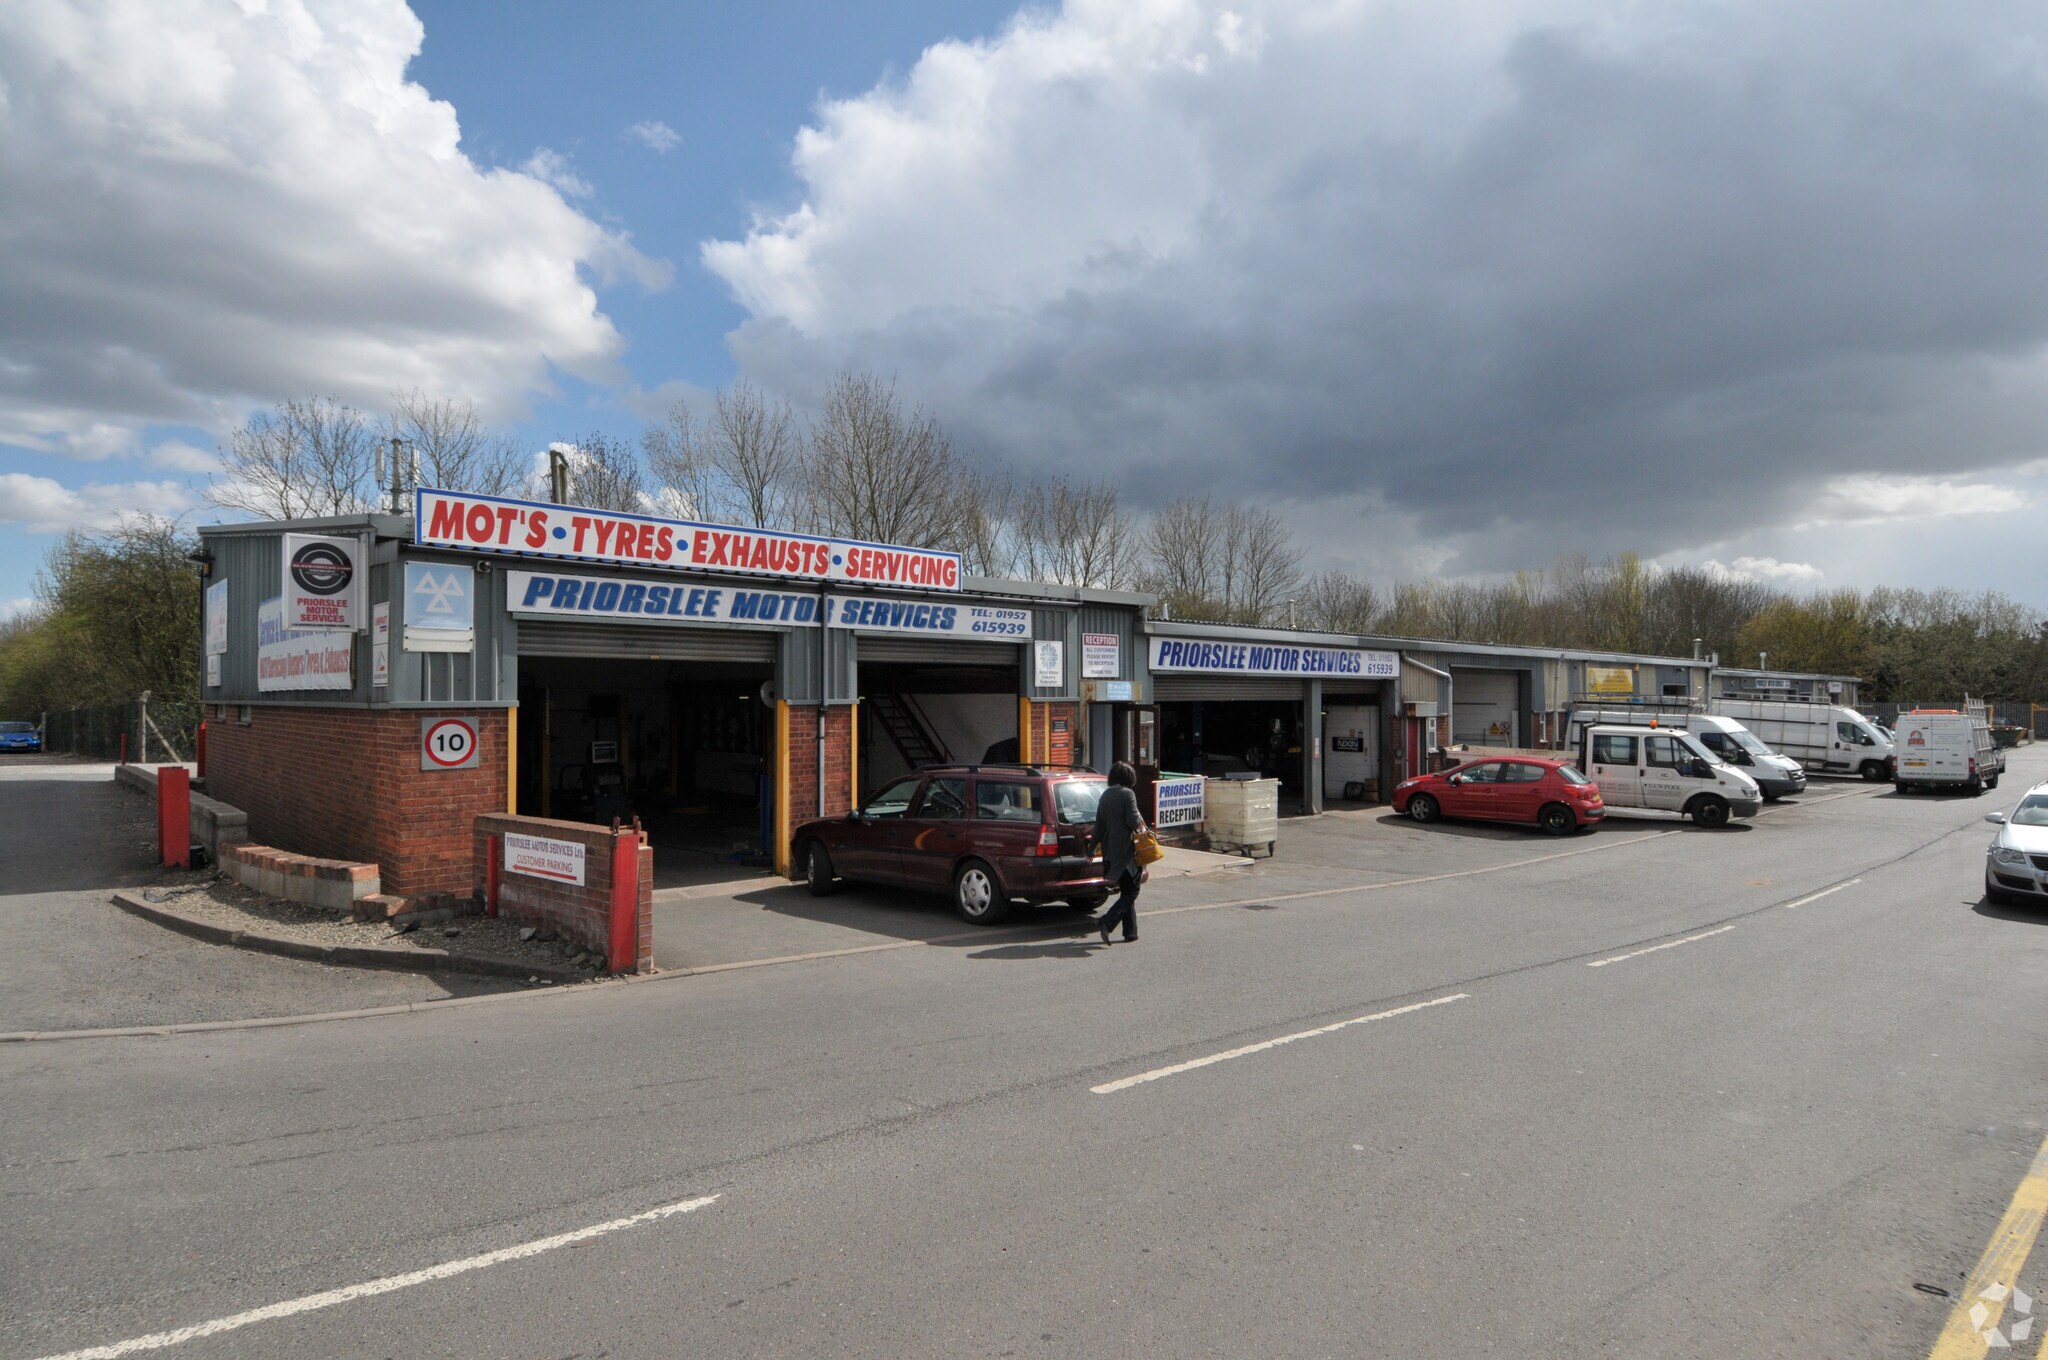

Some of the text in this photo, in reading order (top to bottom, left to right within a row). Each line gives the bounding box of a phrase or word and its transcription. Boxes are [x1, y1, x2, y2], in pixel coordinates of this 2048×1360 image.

[428, 500, 956, 588] MOT'S TYRES EXHAUSTS SERVICING
[297, 597, 348, 608] PRIORSLEE
[522, 576, 957, 631] PRIORSLEE MOTOR SERVICES
[300, 613, 345, 623] SERVICES
[306, 606, 339, 615] MOTOR
[970, 608, 1027, 620] TEL: 01952
[971, 620, 1026, 635] 615939
[1085, 635, 1117, 645] RECEPTION
[1157, 640, 1361, 674] PRIORSLEE MOTOR SERVICES
[1367, 664, 1393, 675] 615939
[437, 733, 464, 752] 10
[1158, 783, 1202, 798] PRIORSLEE
[1158, 796, 1202, 809] MOTOR SERVICES
[1159, 806, 1202, 824] RECEPTION
[506, 836, 531, 850] PRIORSLEE
[531, 840, 549, 853] MOTOR
[549, 842, 574, 857] SERVICES
[516, 854, 573, 873] CUSTOMER PARKING
